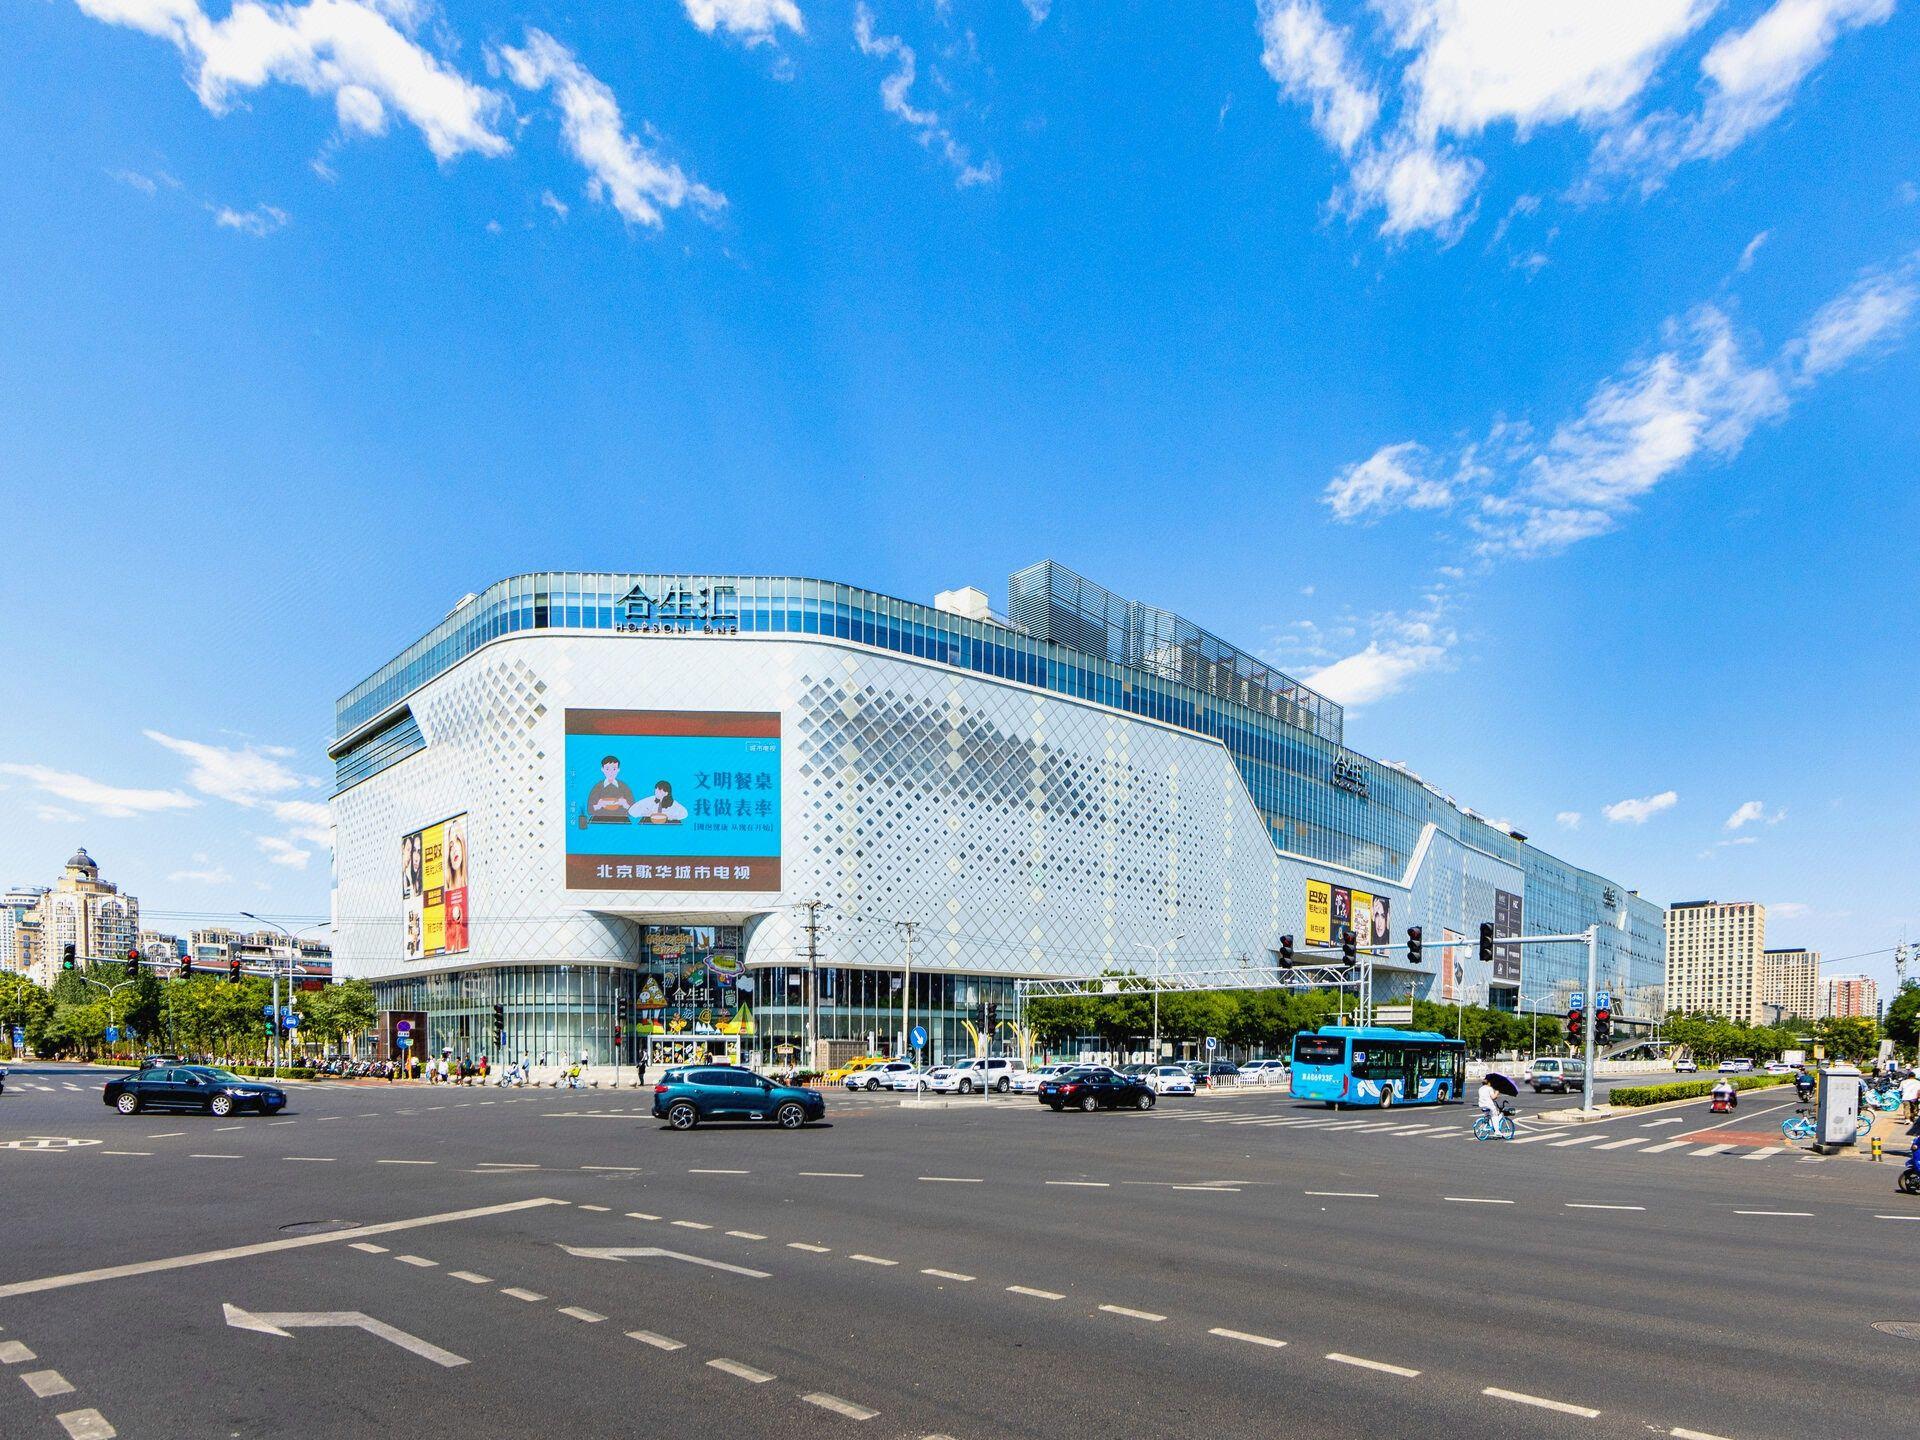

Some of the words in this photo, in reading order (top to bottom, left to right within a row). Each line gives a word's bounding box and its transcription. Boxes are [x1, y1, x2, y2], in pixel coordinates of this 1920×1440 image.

[617, 582, 738, 620] 合生汇
[617, 622, 687, 634] HOPSON
[703, 624, 738, 635] ONE
[694, 771, 772, 790] 文明餐桌
[694, 798, 772, 817] 我做表率
[597, 864, 750, 880] 北京歌华城市电视
[1309, 891, 1328, 905] 巴奴
[672, 987, 715, 1001] 合生汇
